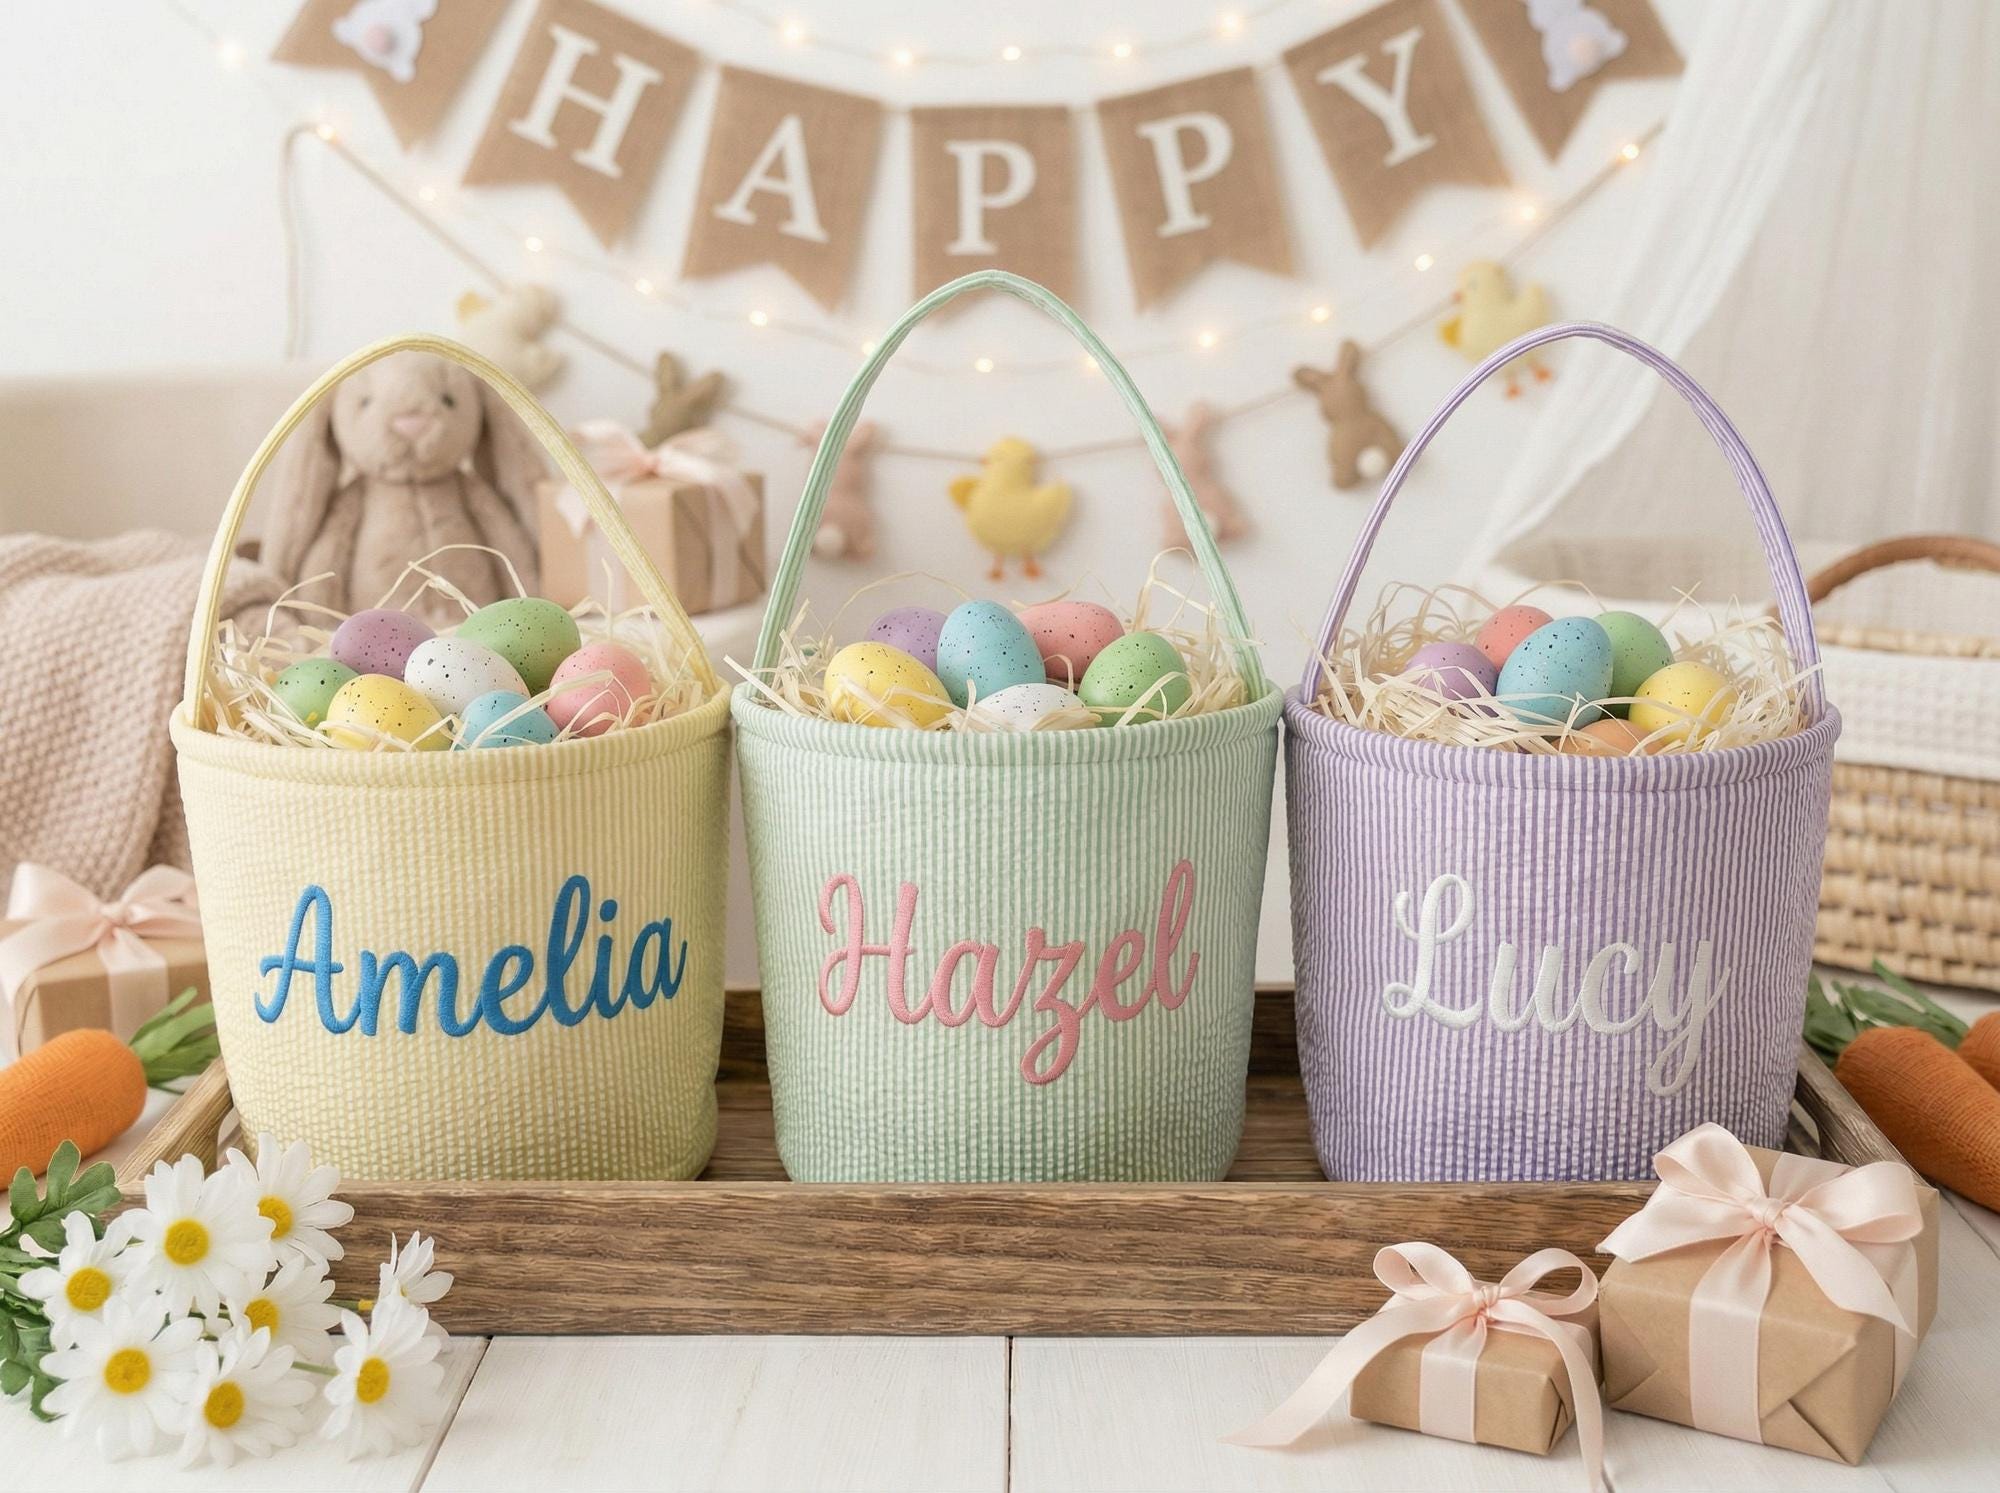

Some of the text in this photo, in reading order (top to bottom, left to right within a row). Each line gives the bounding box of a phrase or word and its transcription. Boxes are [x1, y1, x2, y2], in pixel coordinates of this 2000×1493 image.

[509, 24, 1435, 255] HAPPY
[256, 875, 686, 1037] Amelia
[818, 859, 1199, 1086] Hazel
[1382, 873, 1731, 1097] Lucy
